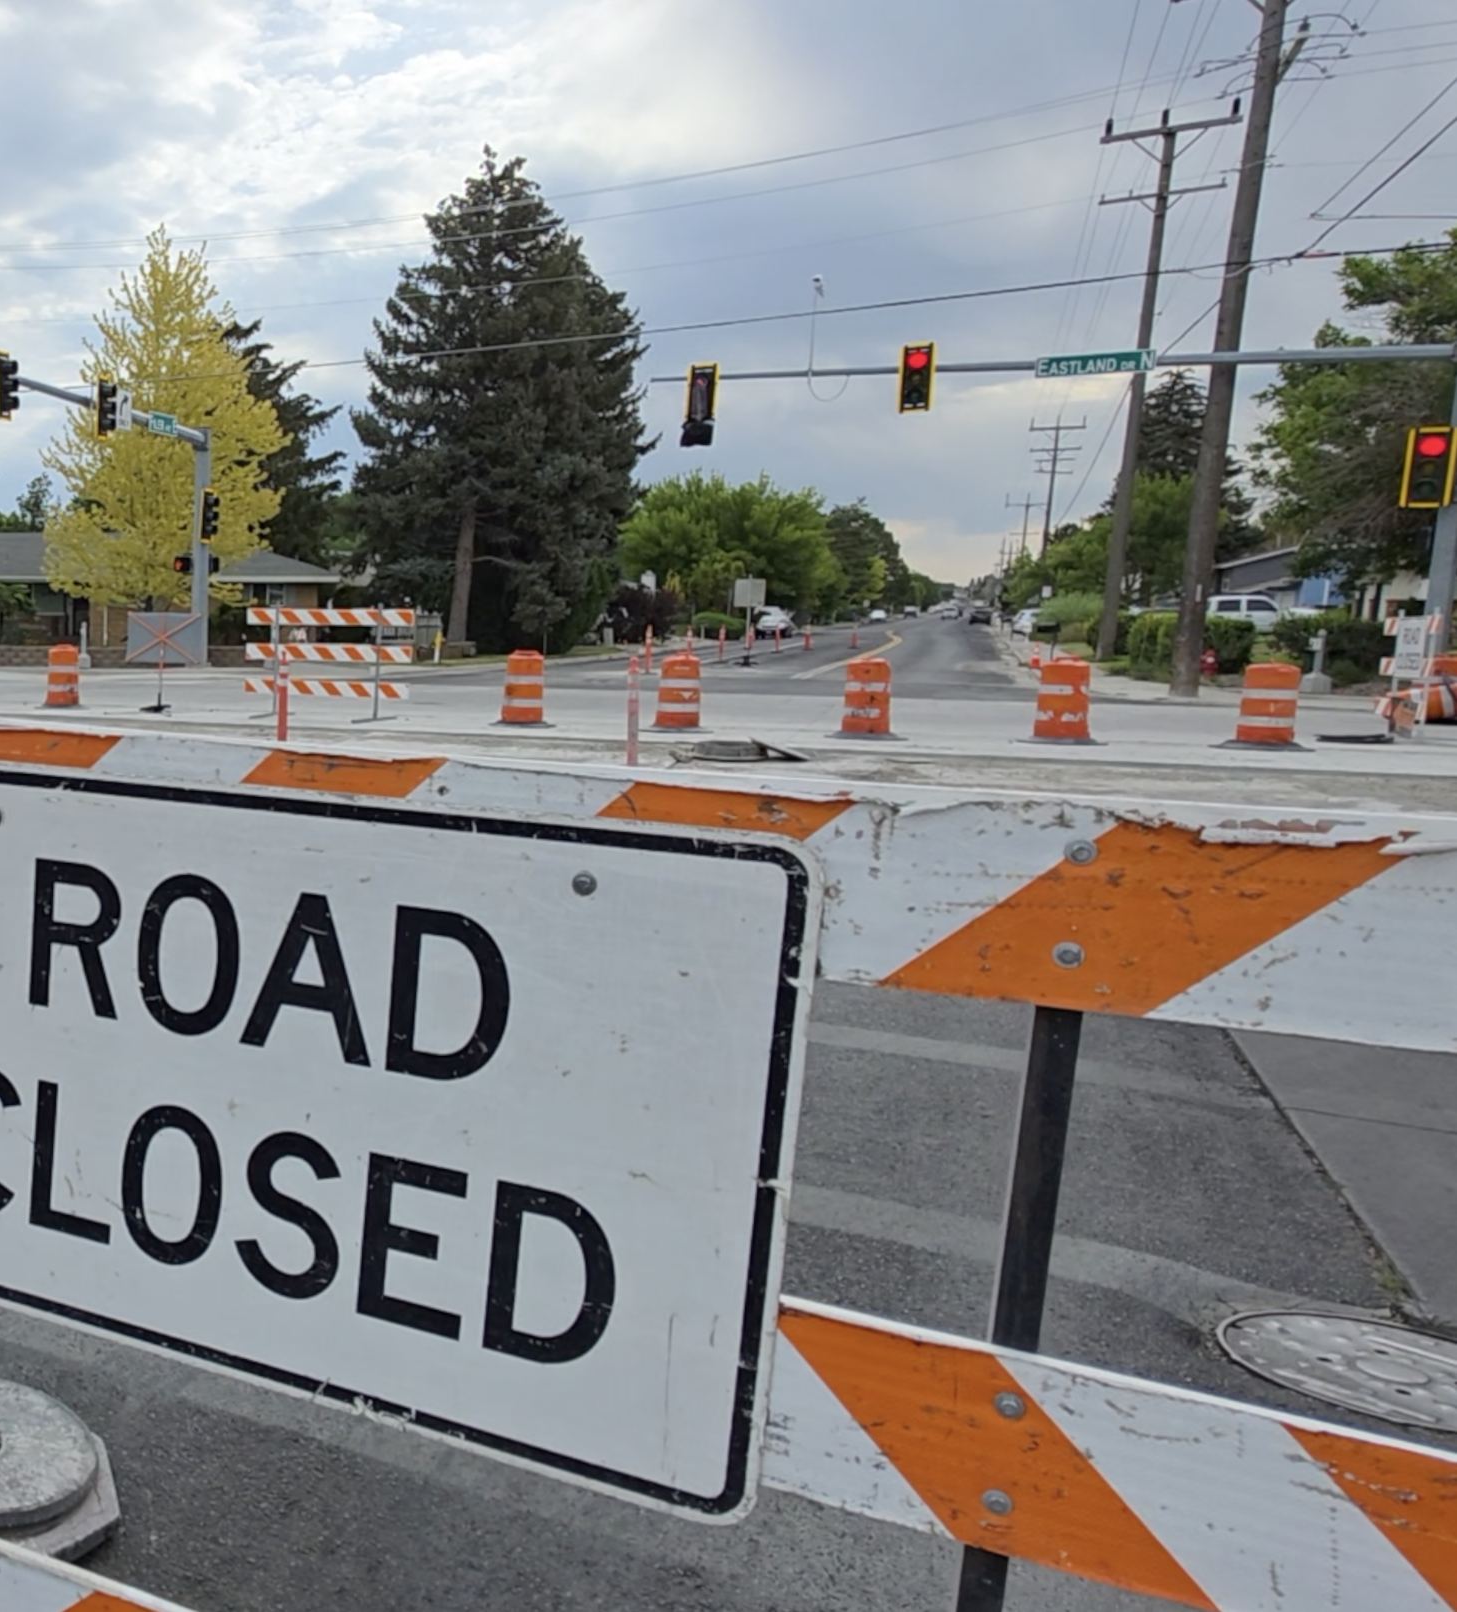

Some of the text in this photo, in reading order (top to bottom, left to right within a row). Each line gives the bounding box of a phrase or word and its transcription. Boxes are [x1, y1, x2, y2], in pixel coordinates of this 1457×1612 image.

[1037, 351, 1154, 376] EASTLAND DR N
[28, 857, 511, 1081] ROAD
